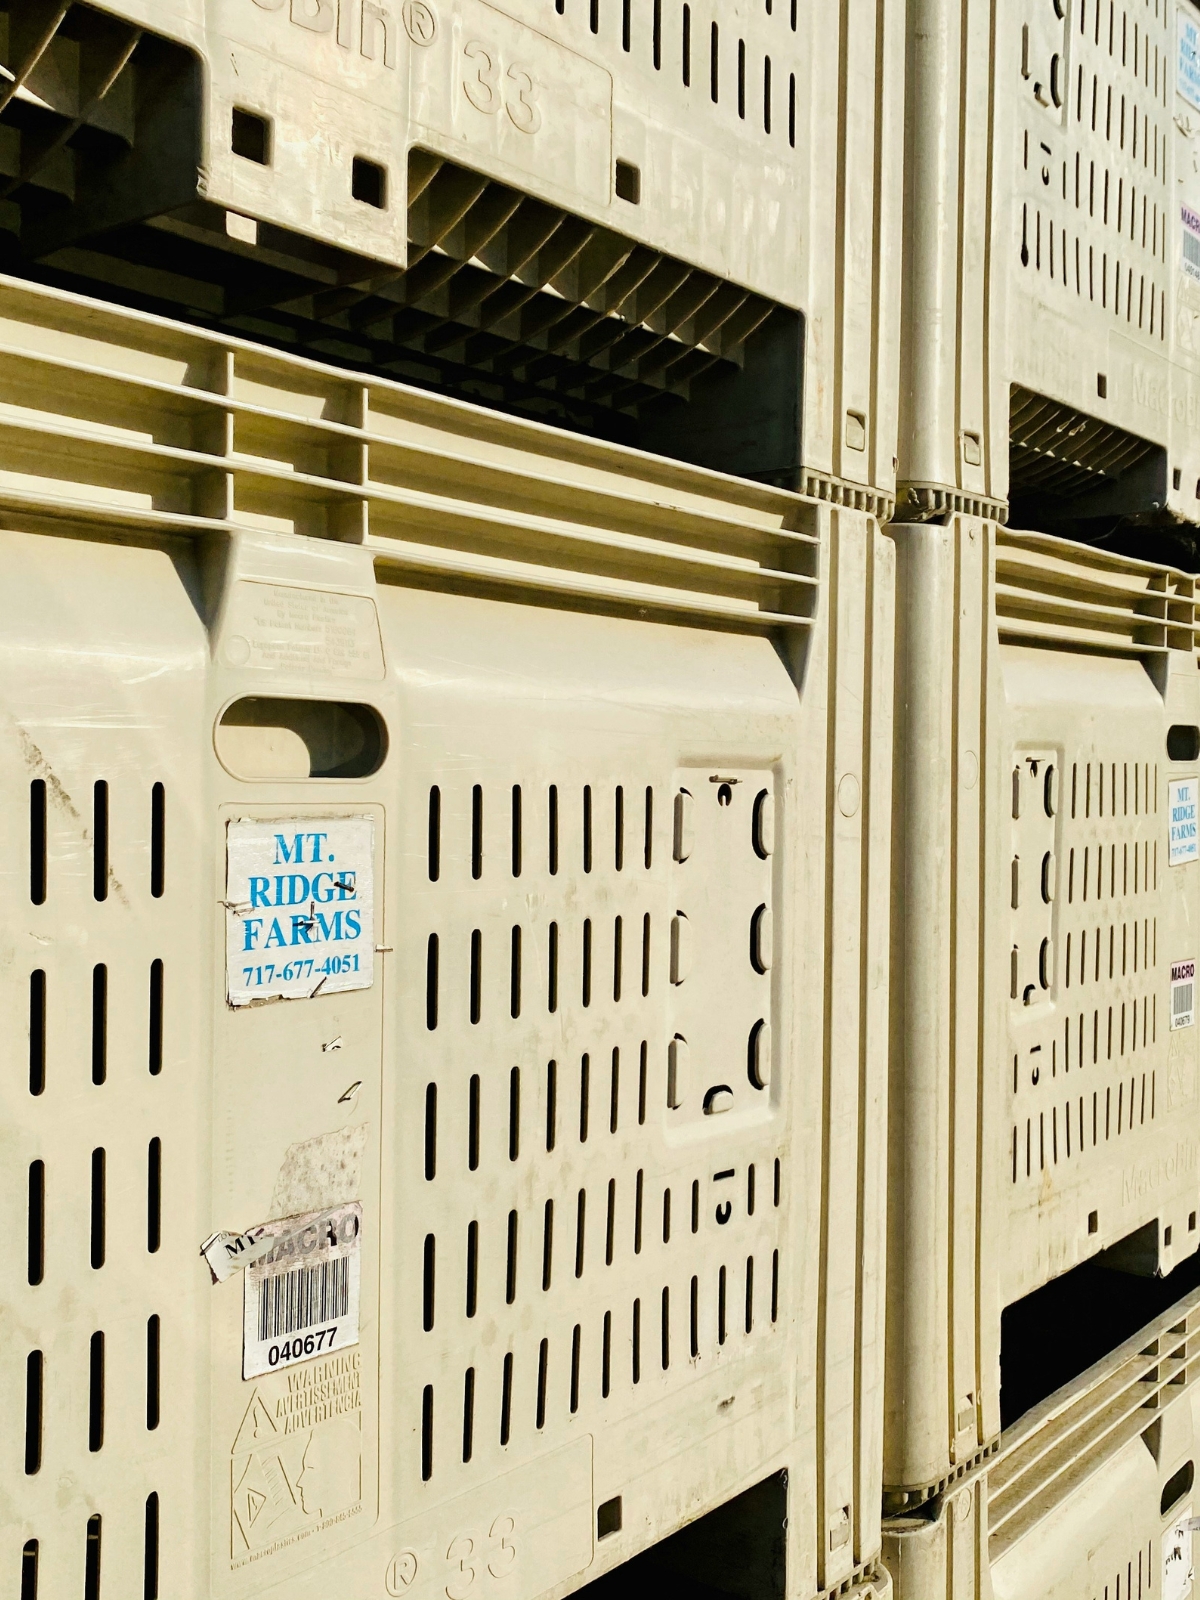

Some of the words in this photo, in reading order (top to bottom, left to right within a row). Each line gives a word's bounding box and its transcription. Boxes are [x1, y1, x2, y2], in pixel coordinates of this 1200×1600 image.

[463, 39, 542, 134] 33
[1172, 804, 1196, 822] RIDGE
[1177, 787, 1191, 803] MT.
[273, 833, 335, 865] MT.
[1171, 822, 1197, 841] FARMS
[248, 871, 357, 908] RIDGE
[242, 909, 362, 951] FARMS
[242, 953, 361, 986] 717-677-4051
[1171, 963, 1195, 981] MACRO
[268, 1326, 338, 1366] 040677
[287, 1353, 361, 1393] WARNING
[276, 1371, 360, 1418] AVERTISSEMENT
[284, 1390, 362, 1435] ADVERTENCIA
[444, 1508, 523, 1600] 33
